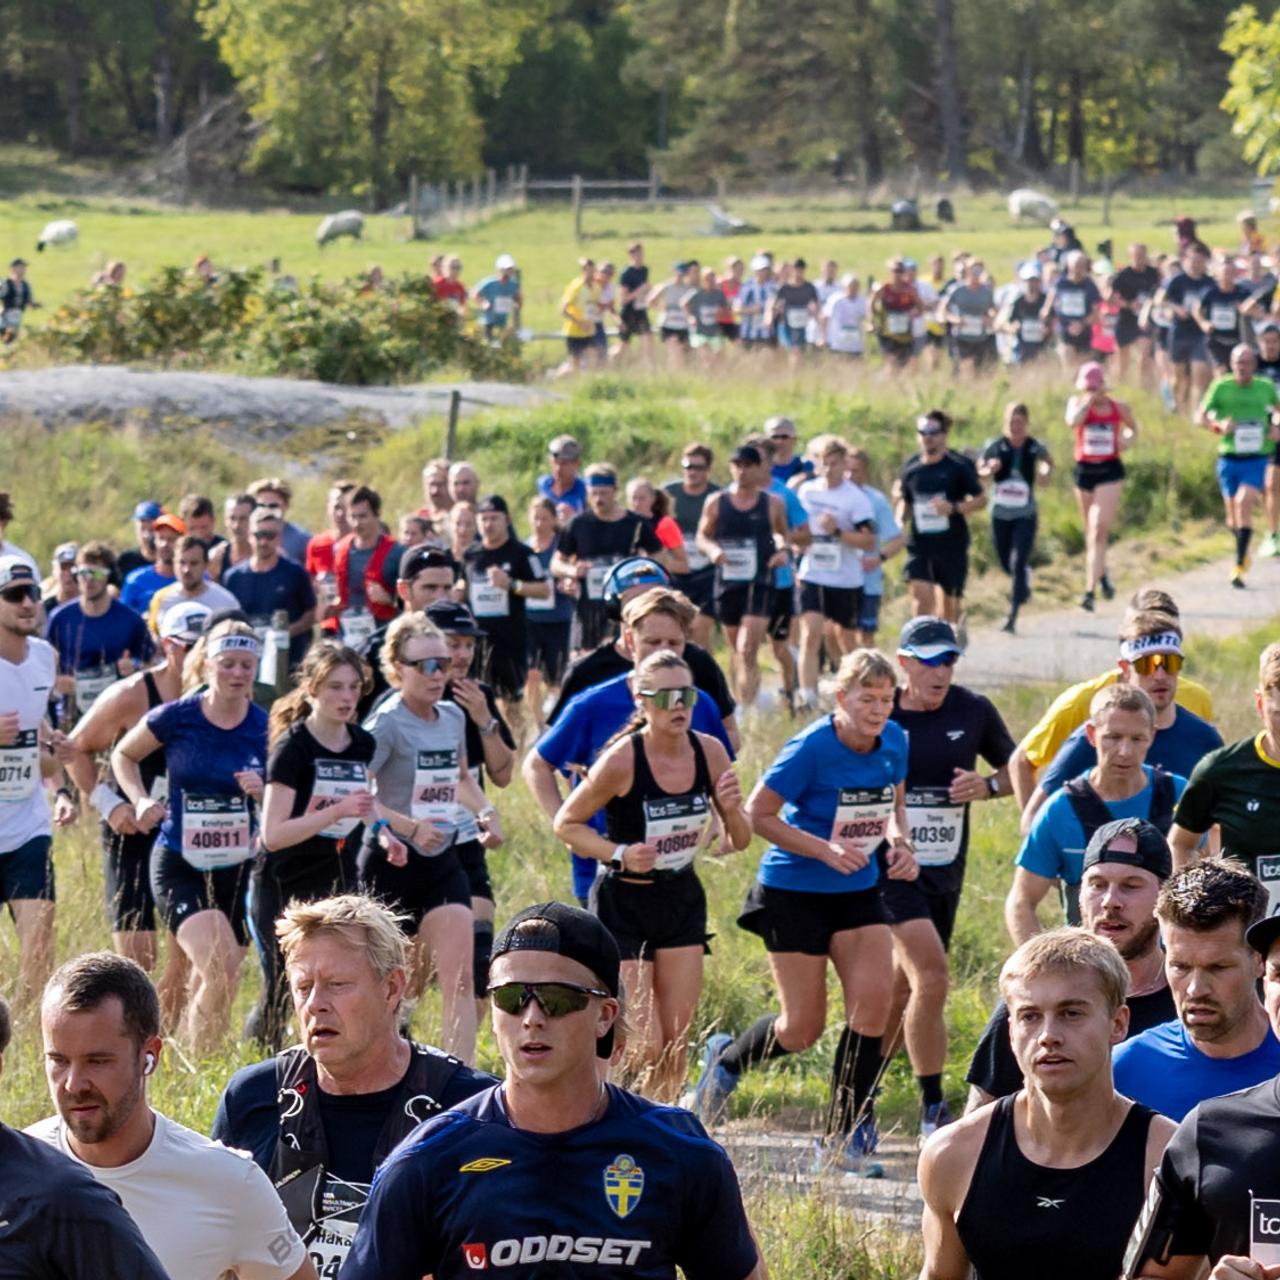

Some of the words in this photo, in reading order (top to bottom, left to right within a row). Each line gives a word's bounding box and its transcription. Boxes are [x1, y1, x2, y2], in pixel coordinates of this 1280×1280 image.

[840, 820, 884, 838] 40025
[192, 831, 240, 848] 40811
[490, 1235, 651, 1267] ODDSET
